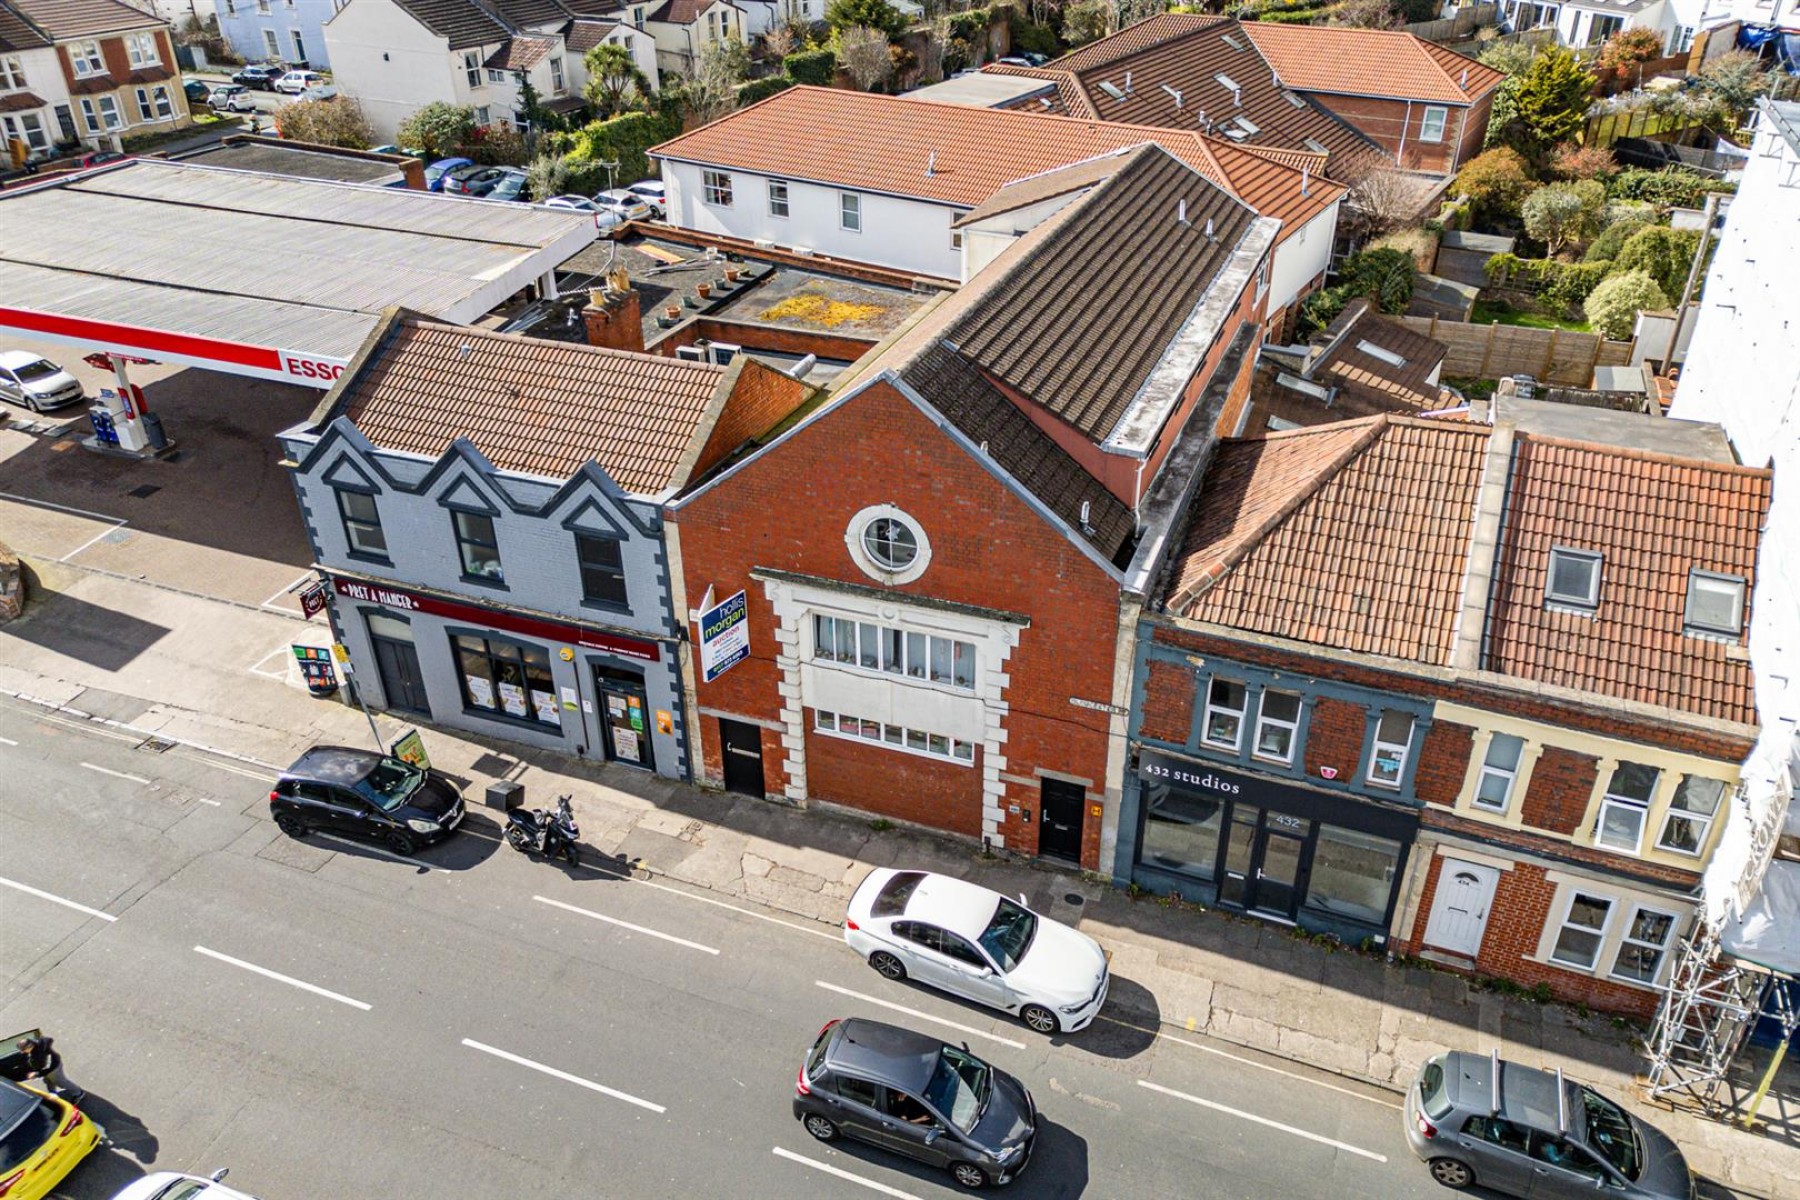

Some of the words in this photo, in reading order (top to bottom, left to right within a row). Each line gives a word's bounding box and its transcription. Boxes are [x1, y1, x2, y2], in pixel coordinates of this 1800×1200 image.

[347, 582, 369, 600] PRET
[371, 588, 378, 602] A
[379, 590, 413, 610] MANGER
[719, 597, 744, 619] hollis
[704, 606, 745, 640] morgan
[711, 625, 740, 648] auction
[1145, 763, 1170, 778] 432
[1173, 771, 1240, 795] studios
[1276, 815, 1300, 829] 432
